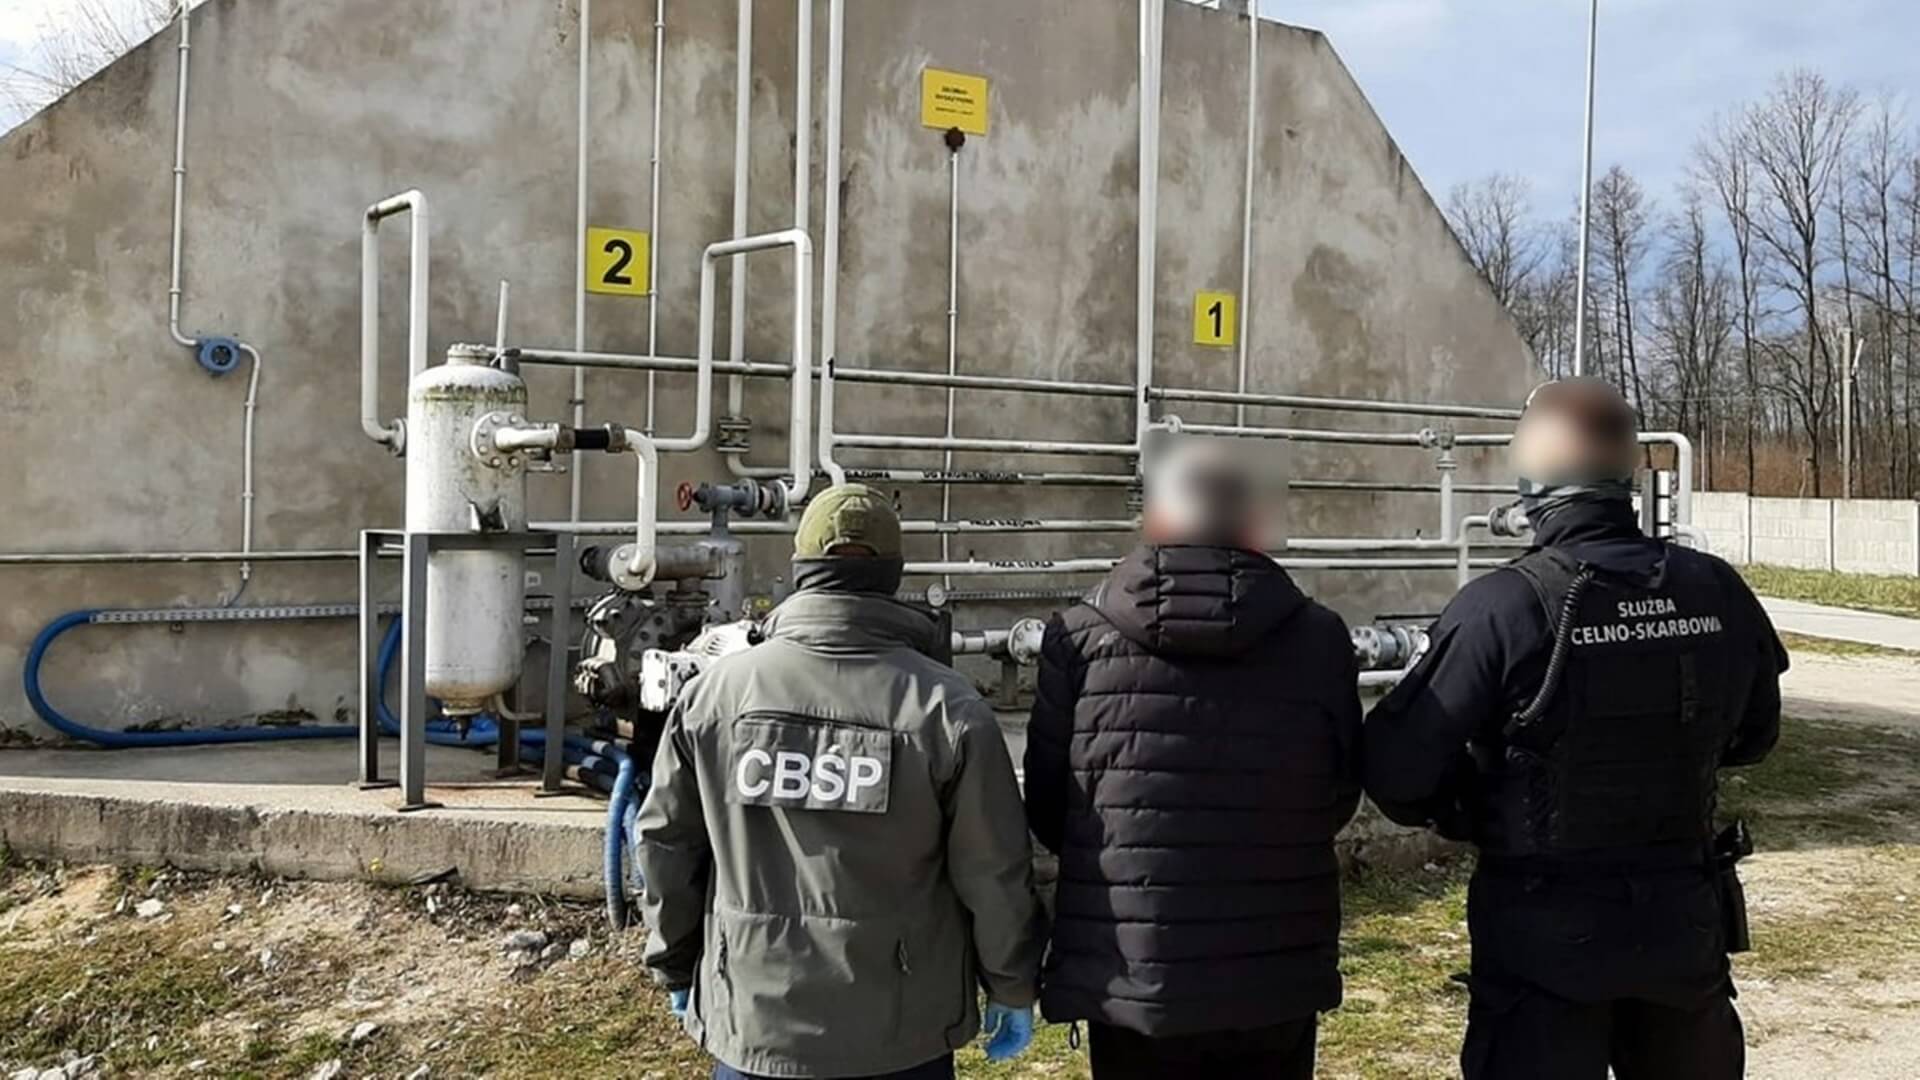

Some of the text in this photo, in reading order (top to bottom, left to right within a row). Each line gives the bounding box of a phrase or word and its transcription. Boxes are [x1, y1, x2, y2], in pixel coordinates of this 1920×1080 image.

[603, 239, 632, 285] 2
[1208, 301, 1221, 337] 1
[1617, 595, 1677, 618] SŁUŻBA
[736, 744, 883, 803] CBŚP
